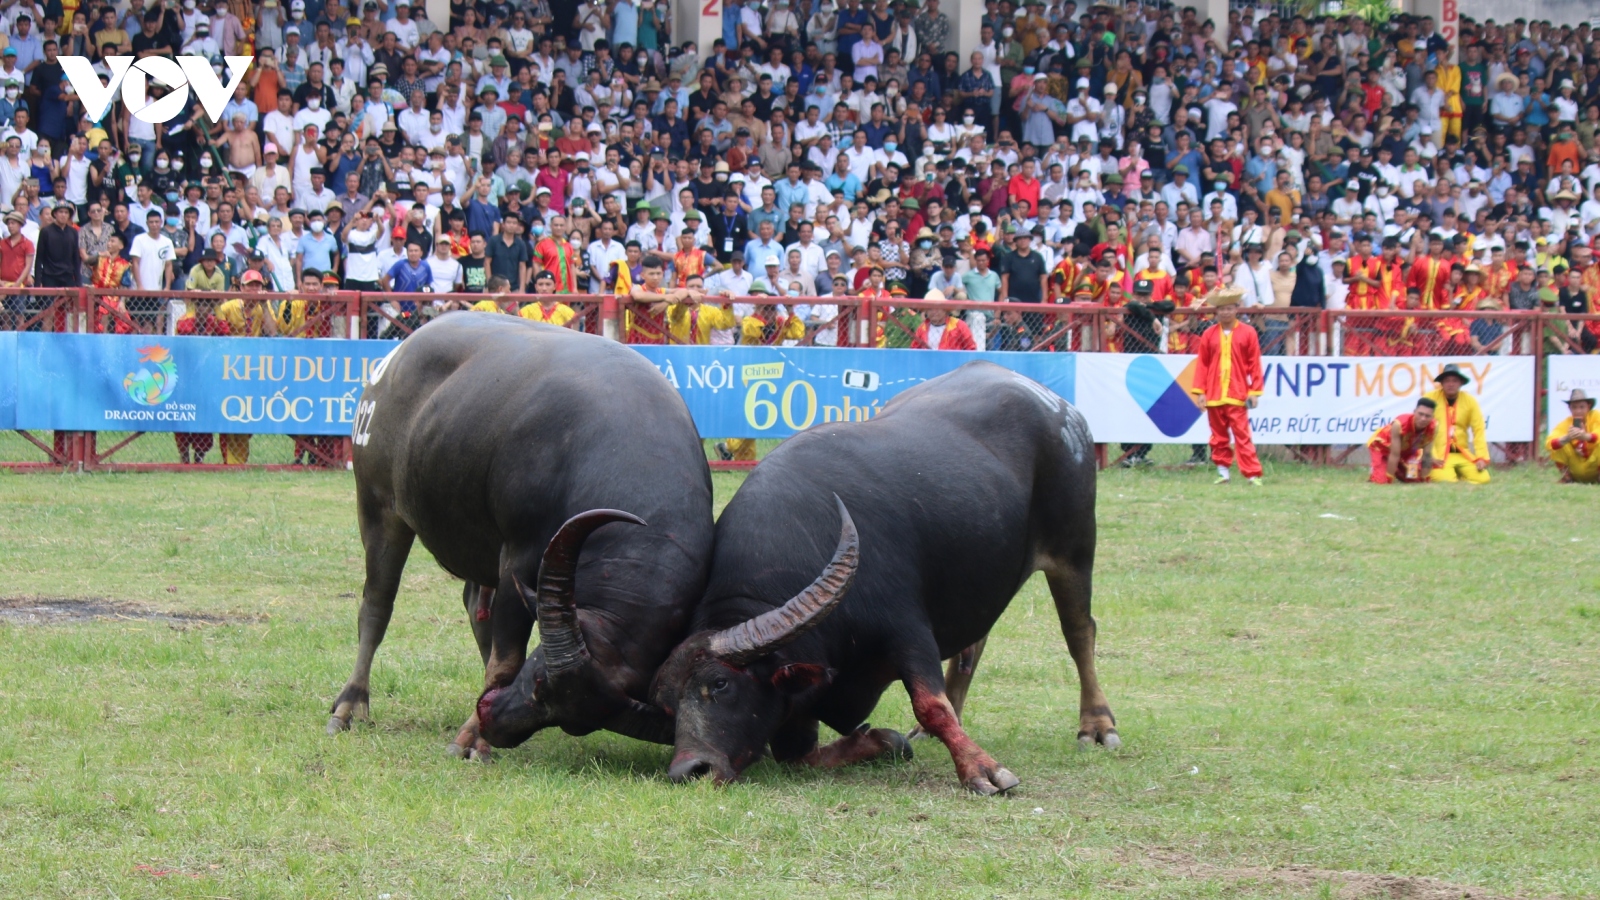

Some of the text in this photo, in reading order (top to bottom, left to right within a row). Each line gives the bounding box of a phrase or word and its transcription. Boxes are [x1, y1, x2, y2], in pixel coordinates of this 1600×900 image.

[222, 355, 288, 381] KHU
[293, 356, 337, 382] DU
[686, 359, 735, 394] NỘI
[1355, 362, 1492, 398] MONY
[104, 409, 196, 422] DRAGON OCEAN
[221, 386, 357, 423] QUỐC TẾ
[744, 379, 888, 431] 60 phú
[1286, 414, 1322, 435] RÚT,
